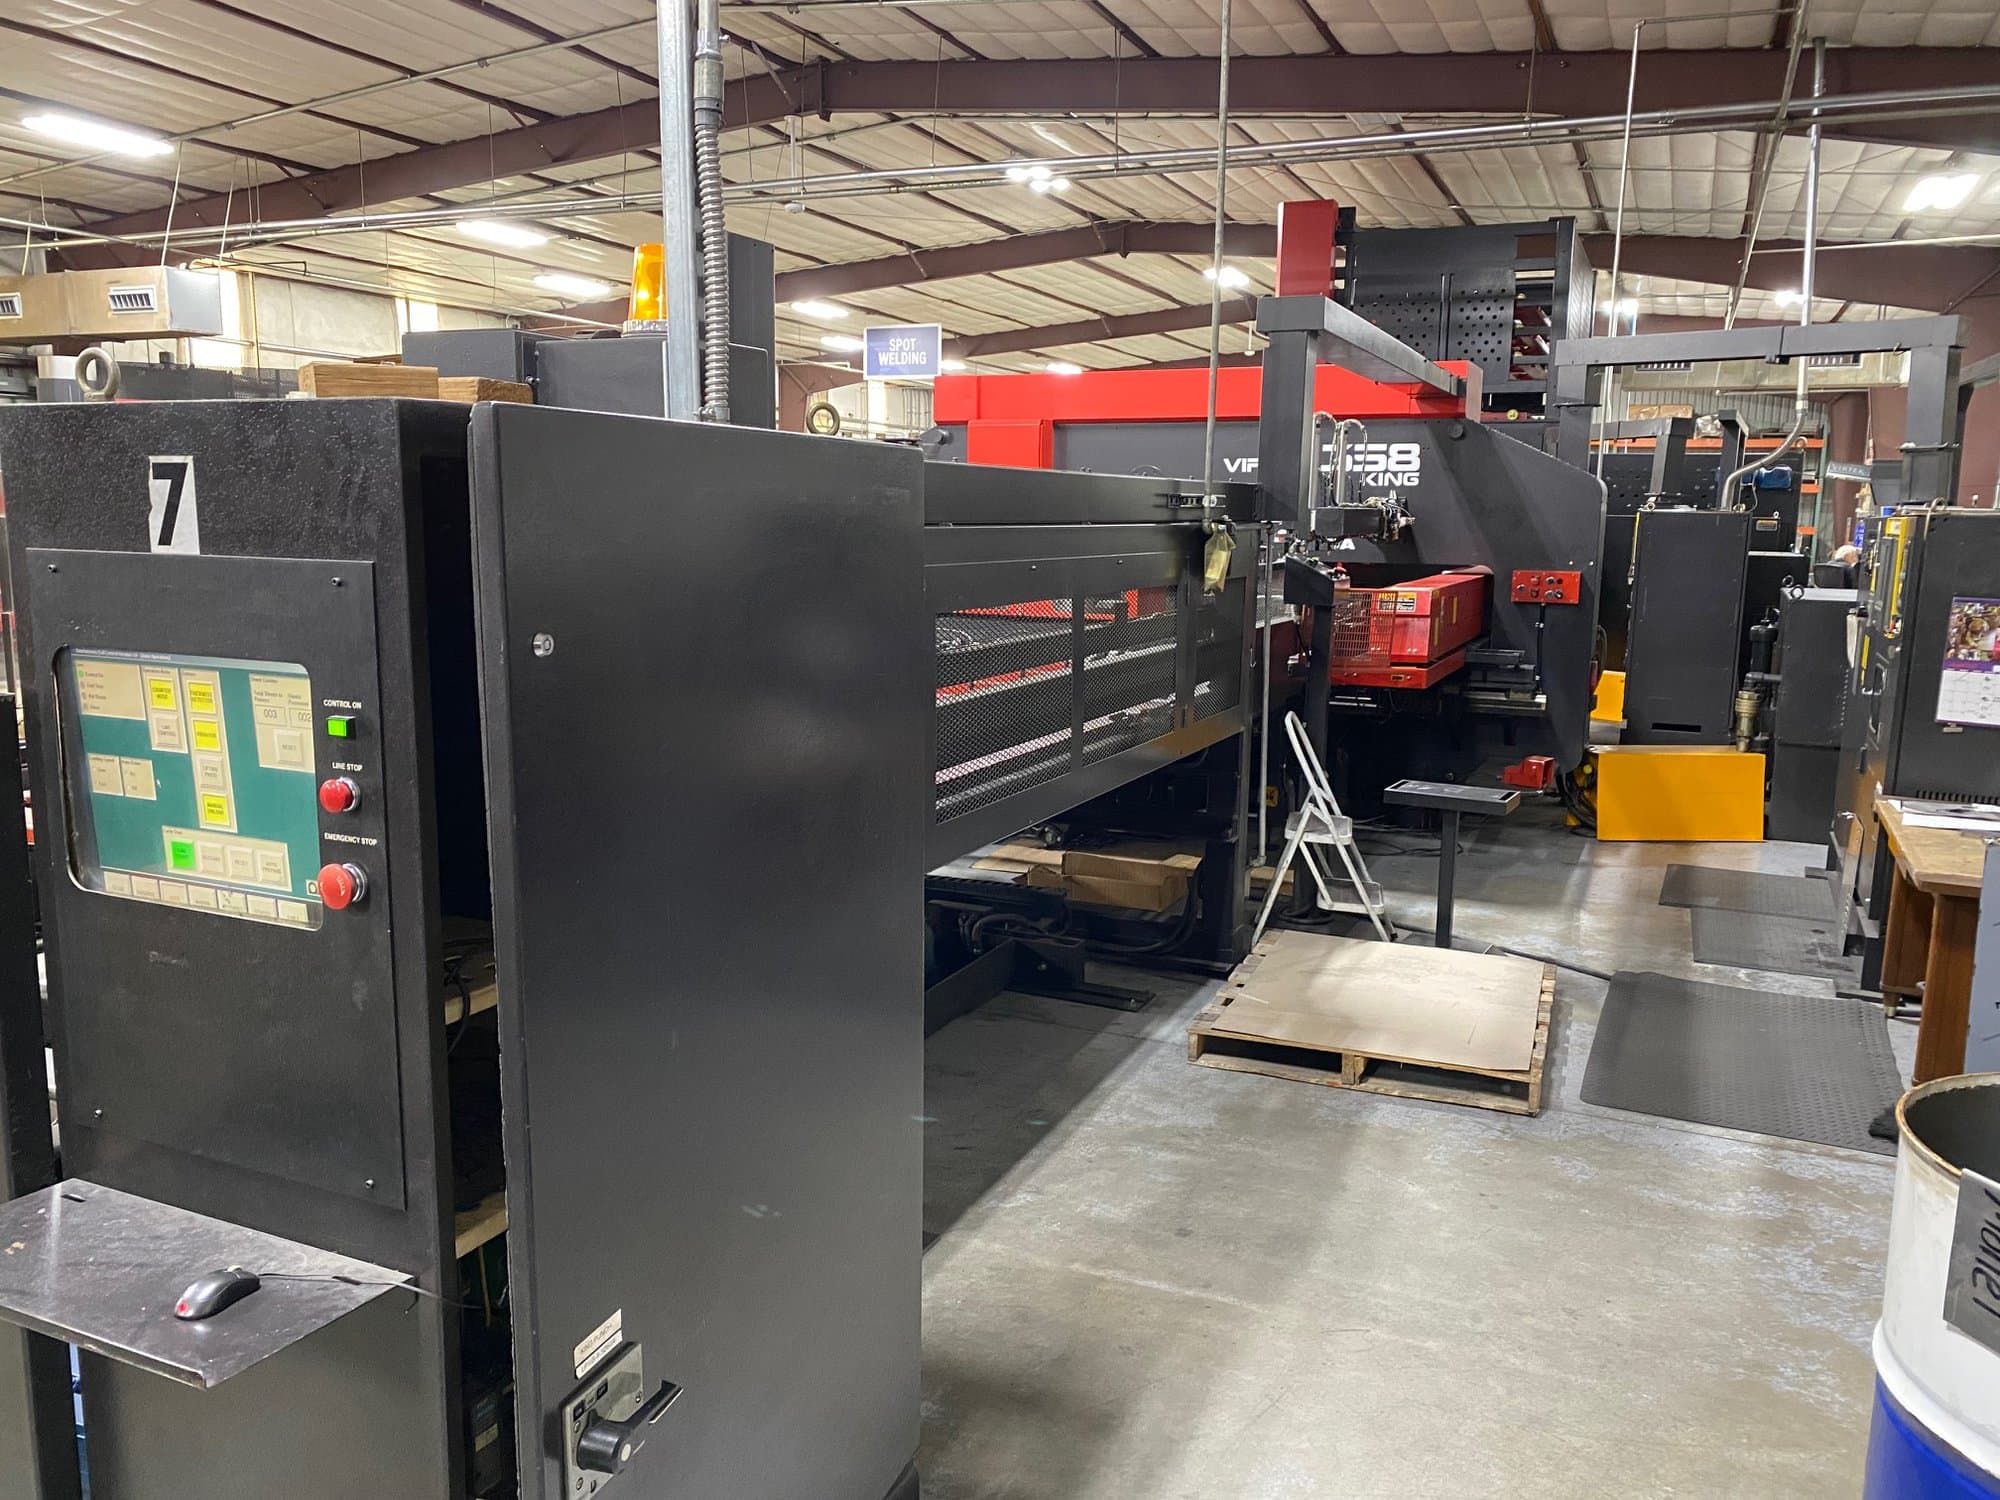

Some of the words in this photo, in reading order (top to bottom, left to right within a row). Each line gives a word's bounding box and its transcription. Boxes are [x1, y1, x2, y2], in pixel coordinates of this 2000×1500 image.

[889, 337, 916, 351] SPOT
[878, 352, 927, 366] WELDING
[1362, 472, 1420, 487] KING
[152, 462, 188, 546] 7
[323, 699, 351, 708] CONTROL
[351, 701, 362, 709] ON
[264, 708, 277, 719] 003
[332, 762, 346, 771] LINE
[347, 763, 363, 772] STOP
[324, 832, 361, 844] EMERGENCY
[361, 836, 377, 846] STOP
